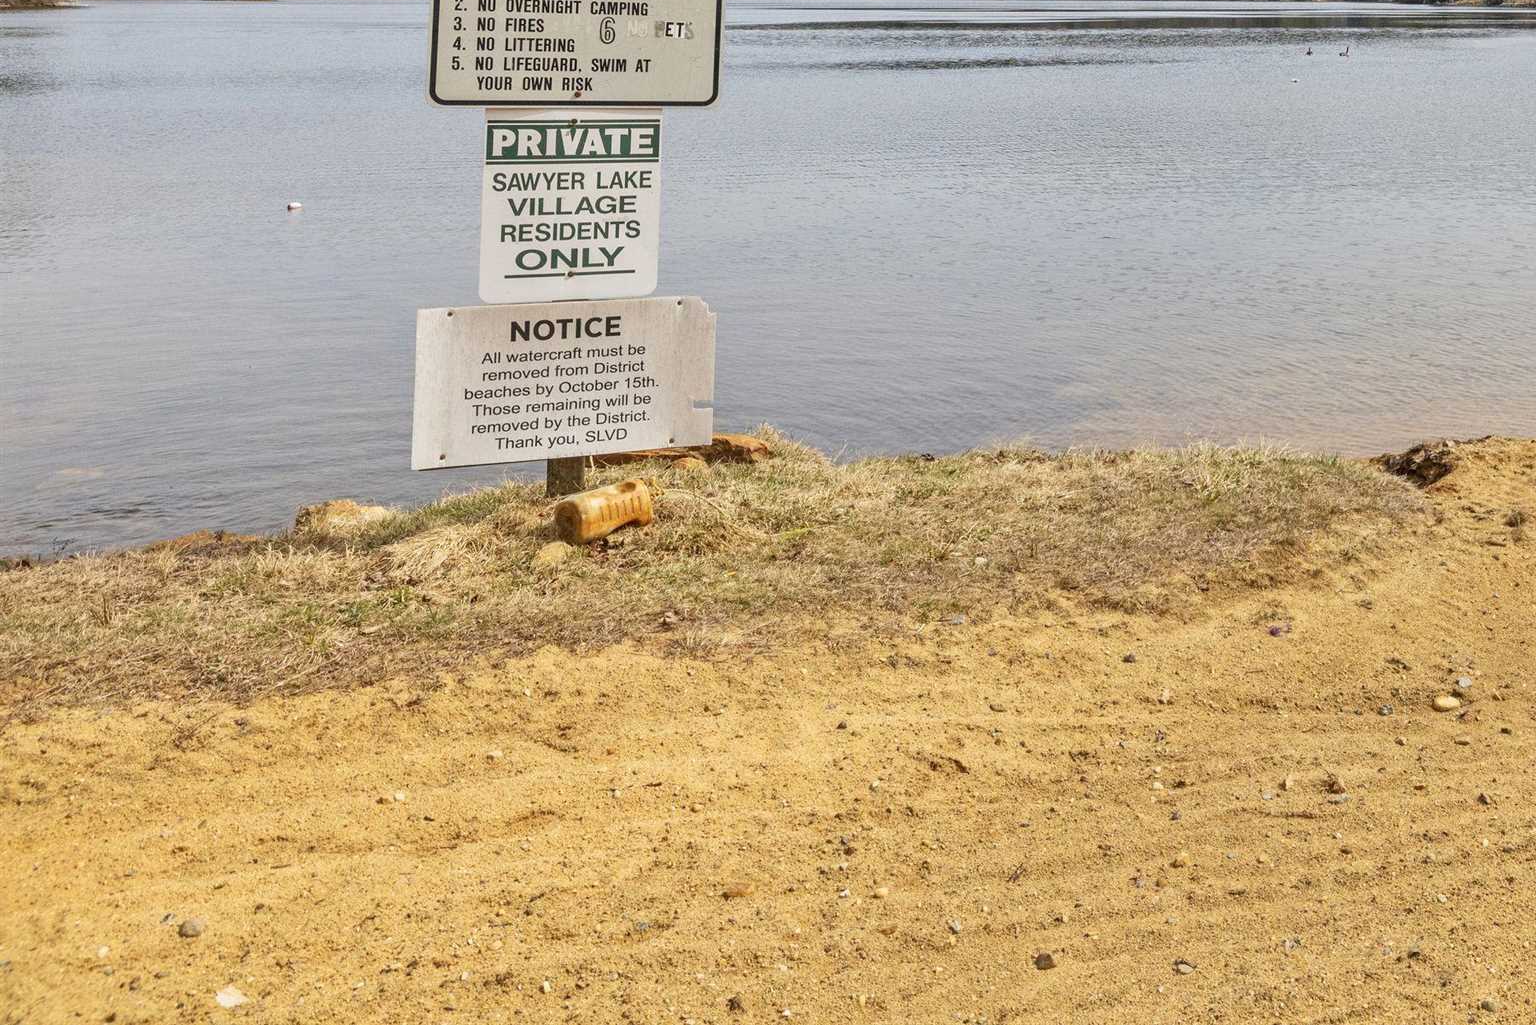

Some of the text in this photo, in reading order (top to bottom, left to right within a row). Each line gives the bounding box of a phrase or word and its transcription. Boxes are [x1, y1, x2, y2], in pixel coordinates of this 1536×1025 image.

[590, 1, 649, 16] CAMPING
[453, 16, 545, 33] 3. NO FIRES
[599, 16, 616, 45] 6
[452, 36, 575, 53] 4. NO LITTERING
[451, 56, 652, 73] 5. NO LIFEGUARD. SWIM AT
[476, 76, 593, 92] YOUR OWN RISK
[492, 127, 655, 157] PRIVATE
[492, 170, 652, 191] SAWYER LAKE
[507, 195, 637, 216] VILLAGE
[500, 220, 641, 243] RESIDENTS
[515, 246, 625, 271] ONLY
[510, 316, 622, 343] NOTICE
[481, 343, 646, 365] All watercraft must be
[482, 360, 645, 382] removed from District
[464, 376, 659, 400] beaches by October 15th.
[472, 393, 651, 417] Those remaining will be
[471, 409, 650, 434] removed by the District.
[495, 428, 628, 450] Thank you, SLVD
